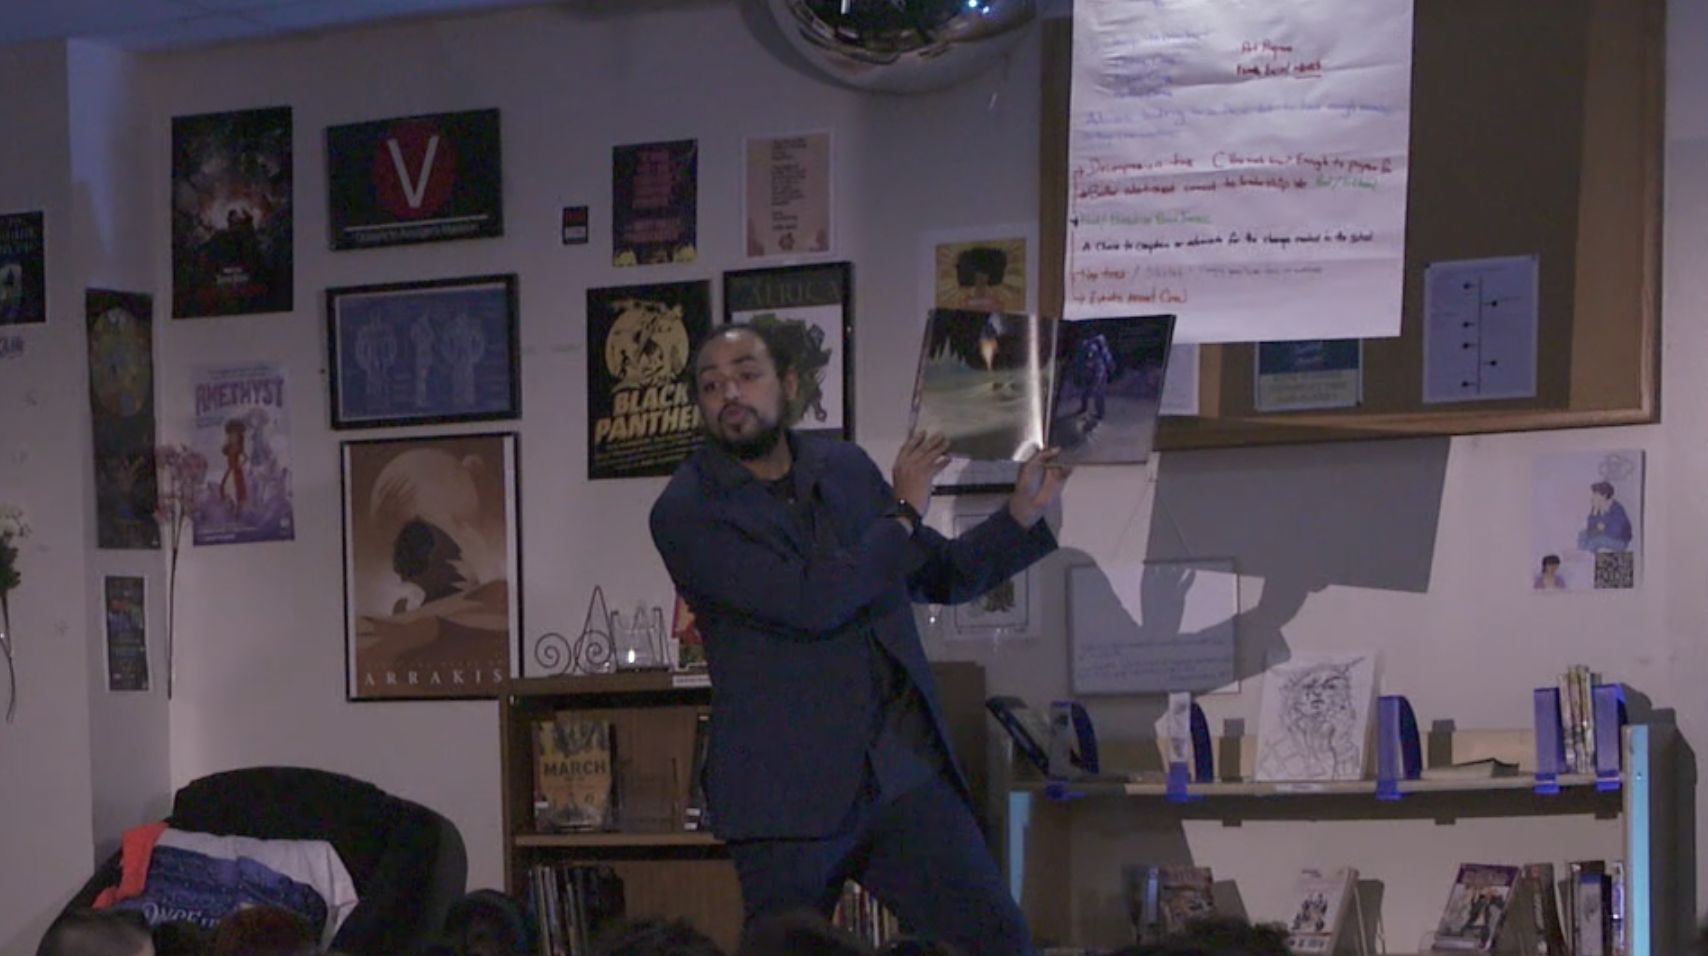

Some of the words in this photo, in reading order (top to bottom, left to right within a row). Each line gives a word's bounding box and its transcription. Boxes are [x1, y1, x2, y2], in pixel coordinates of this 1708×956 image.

[387, 134, 440, 209] V
[745, 277, 841, 306] AFRICA
[195, 375, 284, 416] AMETHYST
[613, 381, 689, 416] BLACK
[365, 668, 504, 687] ARRAKIS
[544, 760, 607, 777] MARCH
